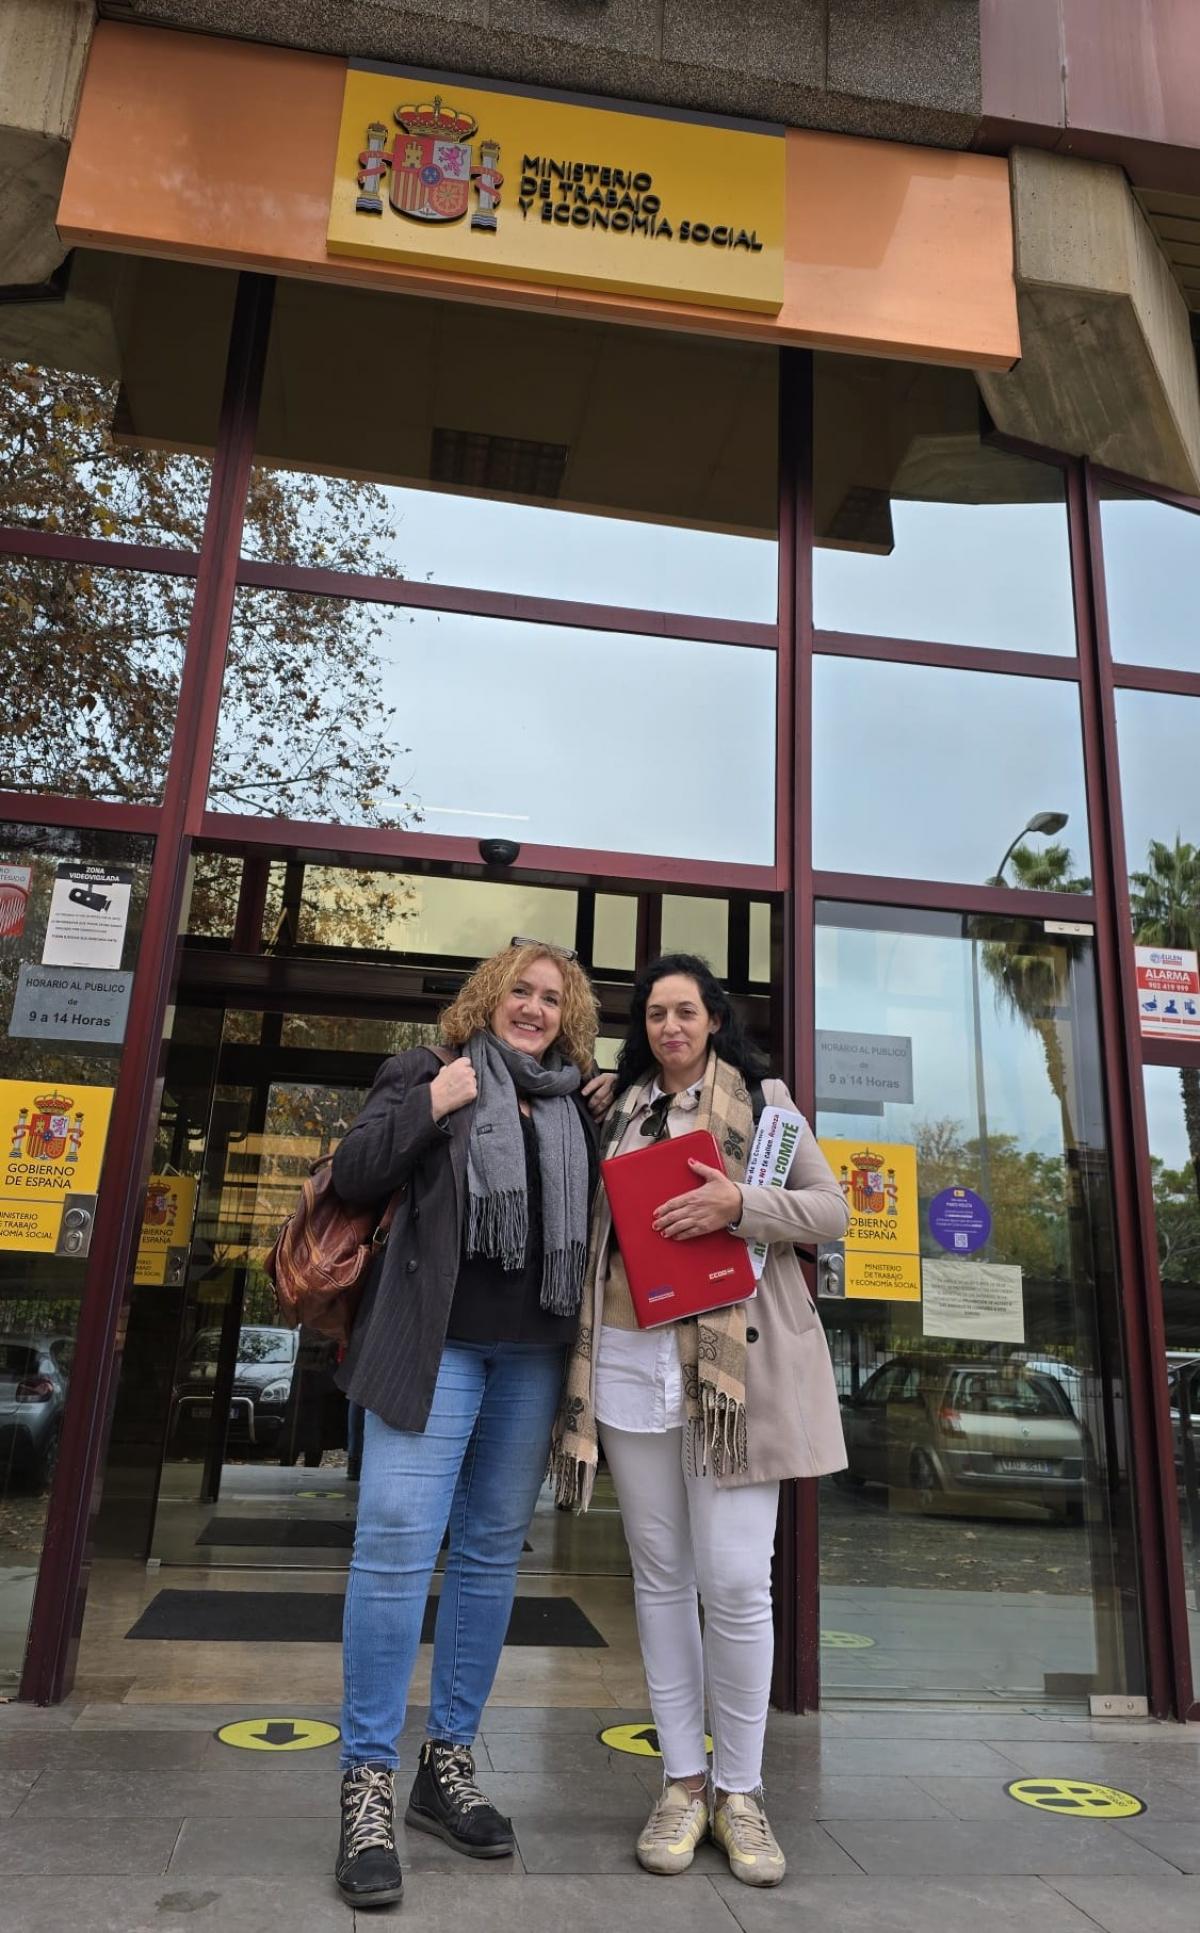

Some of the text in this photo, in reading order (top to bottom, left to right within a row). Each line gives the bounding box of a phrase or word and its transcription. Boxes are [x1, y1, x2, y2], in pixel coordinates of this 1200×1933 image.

[522, 154, 652, 193] MINISTERIO
[520, 176, 661, 215] DE TRABAJO
[518, 196, 534, 221] Y
[679, 220, 763, 253] SOCIAL
[69, 872, 120, 881] VIDEOVIGILADA
[1145, 968, 1190, 981] ALARMA
[26, 978, 69, 990] HORARIO
[70, 982, 82, 991] AL
[67, 998, 78, 1006] de
[29, 1010, 111, 1027] 9 a 14 Horas
[829, 1073, 900, 1089] 9 a 14 Horas
[759, 1168, 767, 1178] NO
[768, 1114, 780, 1137] Avanza
[775, 1122, 799, 1174] COMITÉ
[8, 1163, 75, 1176] GOBIERNO
[5, 1175, 71, 1189] DE ESPAÑA
[0, 1211, 38, 1221] INISTERIO
[4, 1220, 38, 1230] TRABAJO
[849, 1217, 897, 1229] OBIERNO
[858, 1228, 897, 1241] ESPAÑA
[865, 1263, 902, 1272] MINISTERIO
[874, 1272, 903, 1281] TRABAJO
[894, 1281, 918, 1289] SOCIAL
